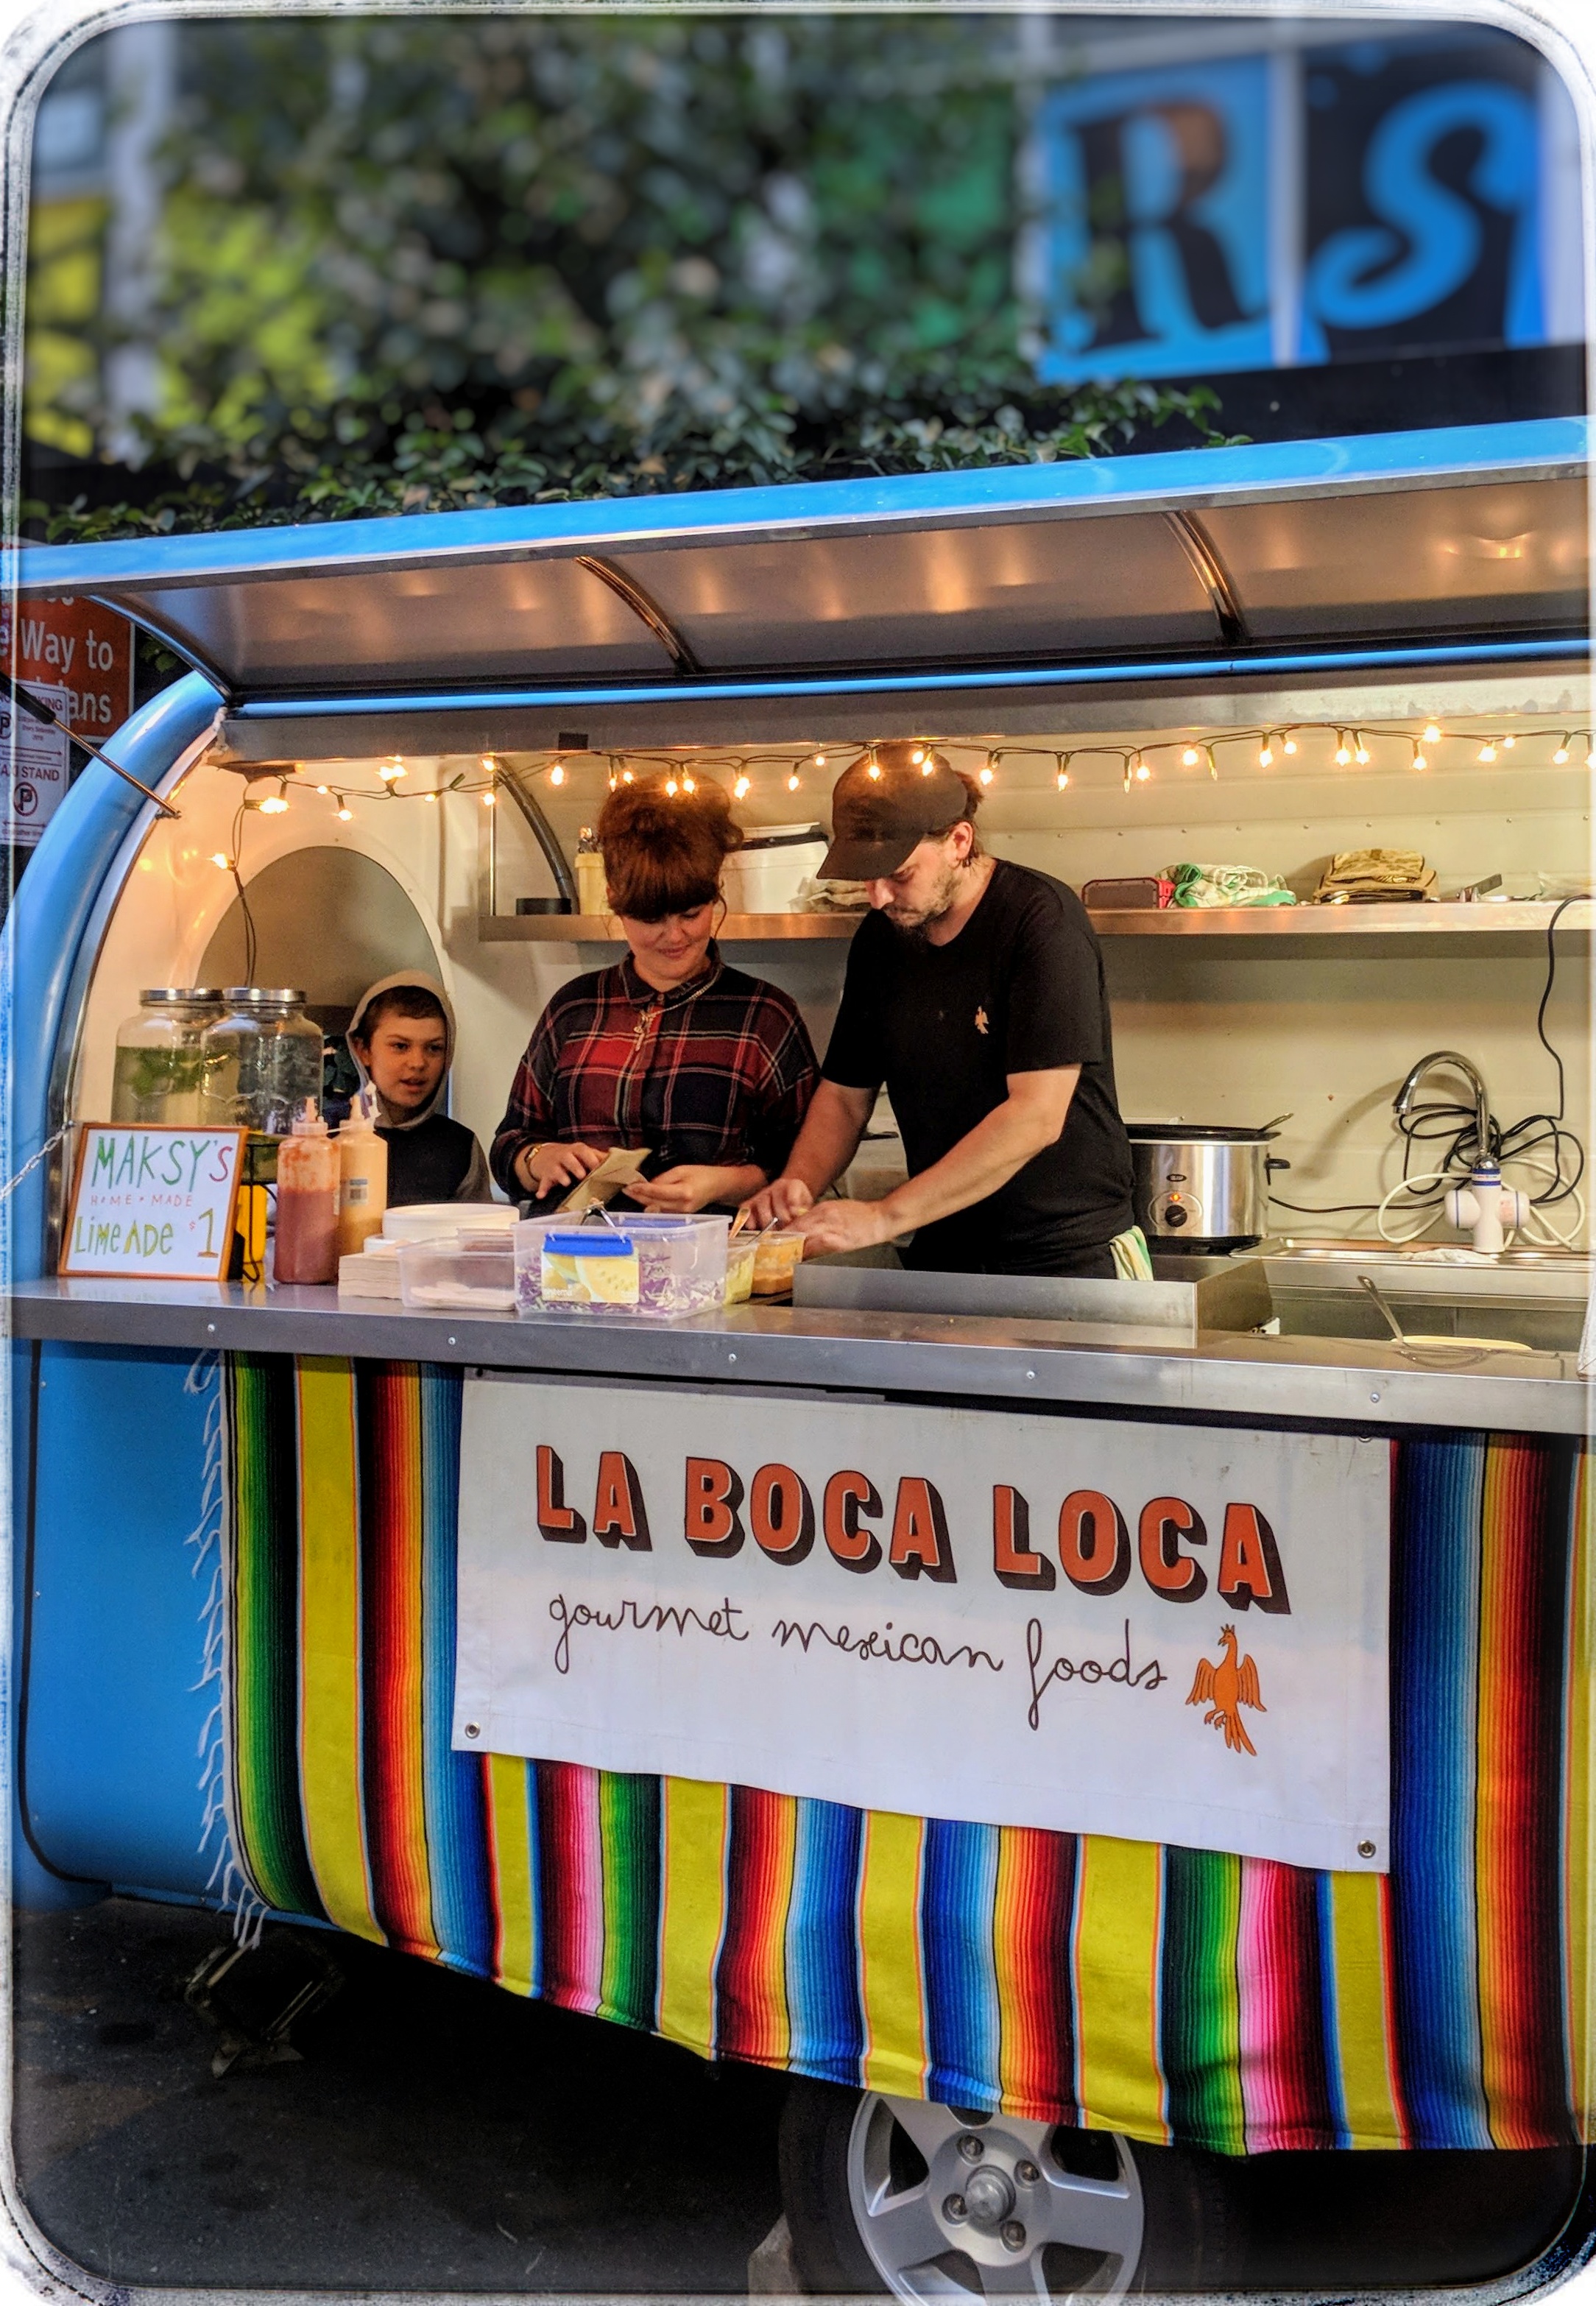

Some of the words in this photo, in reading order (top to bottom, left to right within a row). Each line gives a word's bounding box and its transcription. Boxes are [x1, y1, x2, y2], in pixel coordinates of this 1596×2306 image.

[20, 618, 75, 674] Way
[86, 629, 113, 671] to
[21, 766, 60, 781] STAND
[91, 1134, 233, 1193] MAKSY'S
[151, 1195, 193, 1206] MADE
[536, 1445, 652, 1551] LA
[684, 1456, 957, 1583] BOCA
[993, 1484, 1292, 1615] LOCA
[548, 1593, 749, 1674] gourmet
[771, 1618, 1003, 1671] mexican
[1026, 1618, 1168, 1730] foods
